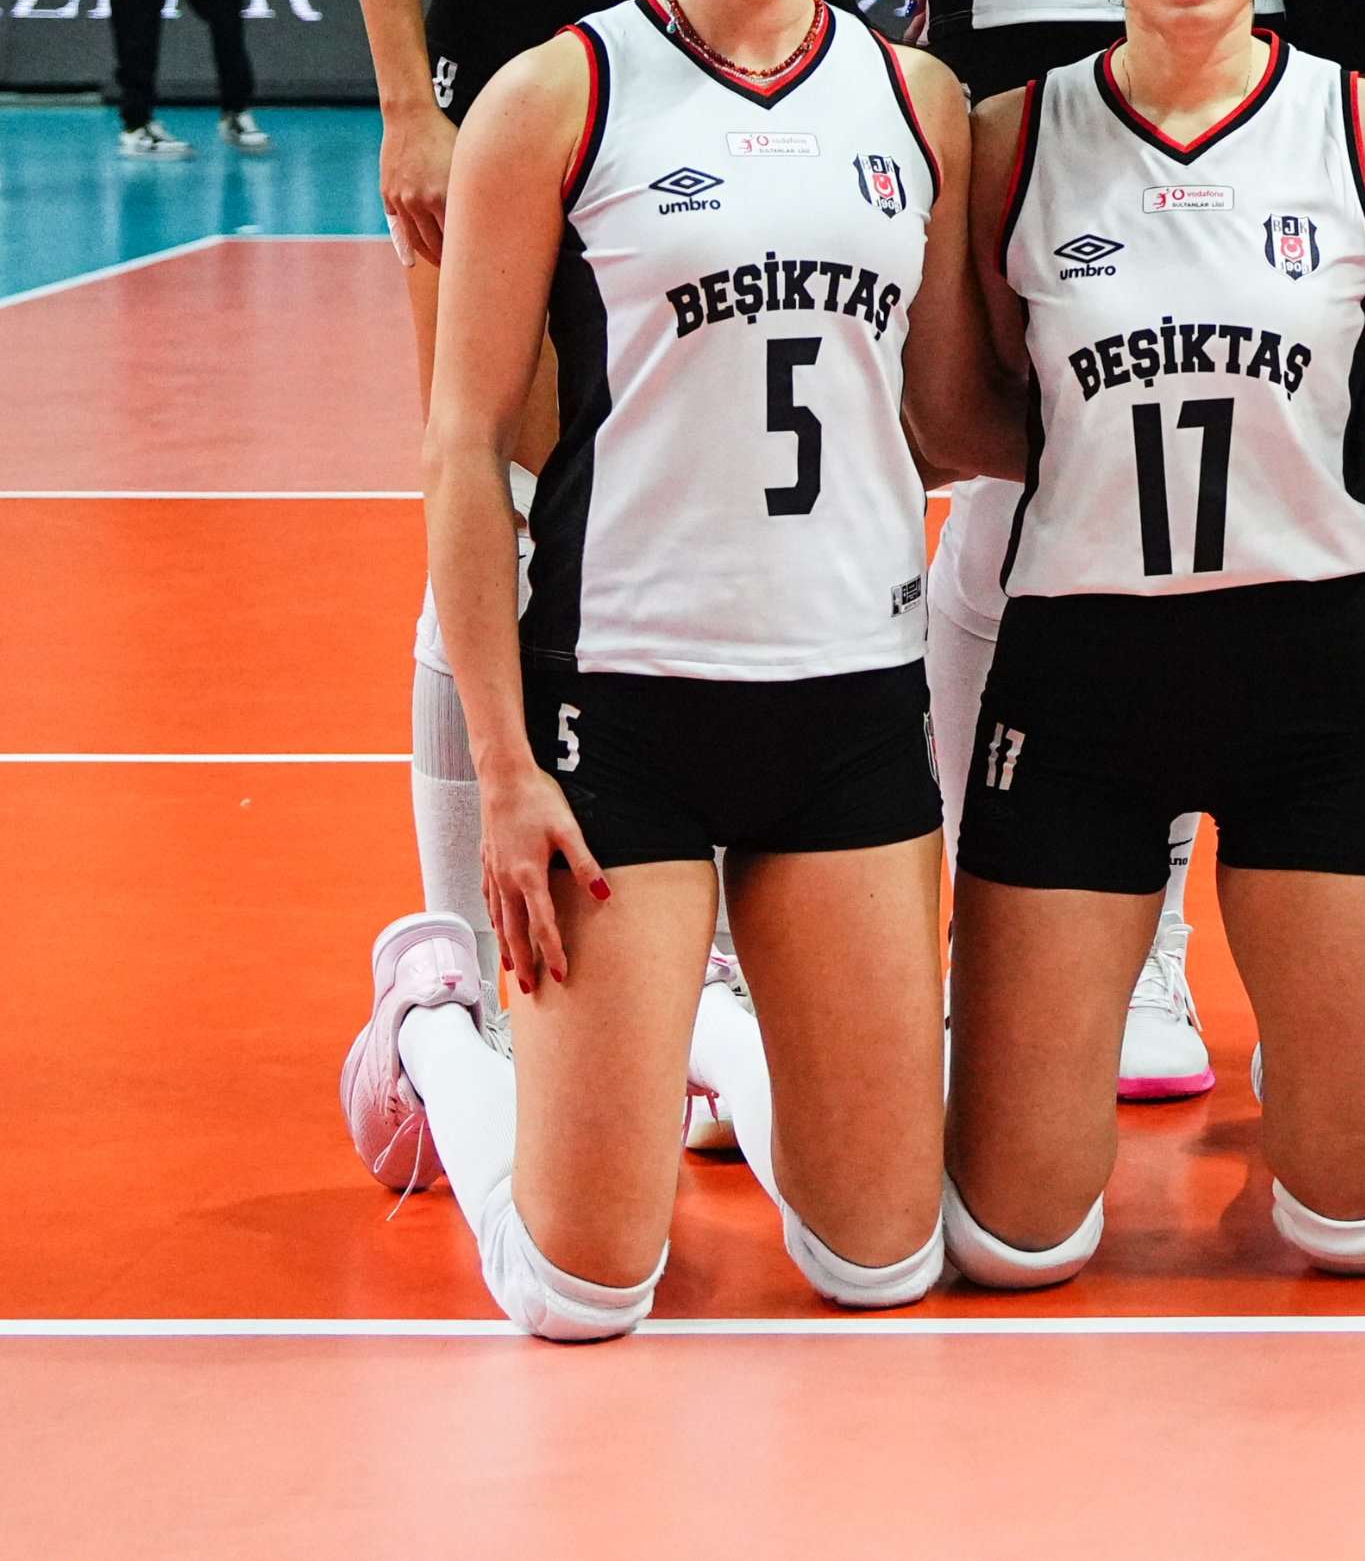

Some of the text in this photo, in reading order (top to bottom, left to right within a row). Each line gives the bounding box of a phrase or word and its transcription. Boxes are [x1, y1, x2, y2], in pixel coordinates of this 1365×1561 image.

[658, 198, 721, 215] umbro
[1186, 190, 1224, 198] vodafone
[1273, 219, 1308, 235] BJK
[665, 251, 901, 341] BEŞİKTAŞ
[1059, 264, 1117, 280] umbro
[1068, 315, 1312, 402] BEŞİKTAŞ
[764, 336, 823, 517] 5
[1132, 397, 1236, 577] 17
[557, 702, 582, 772] 5
